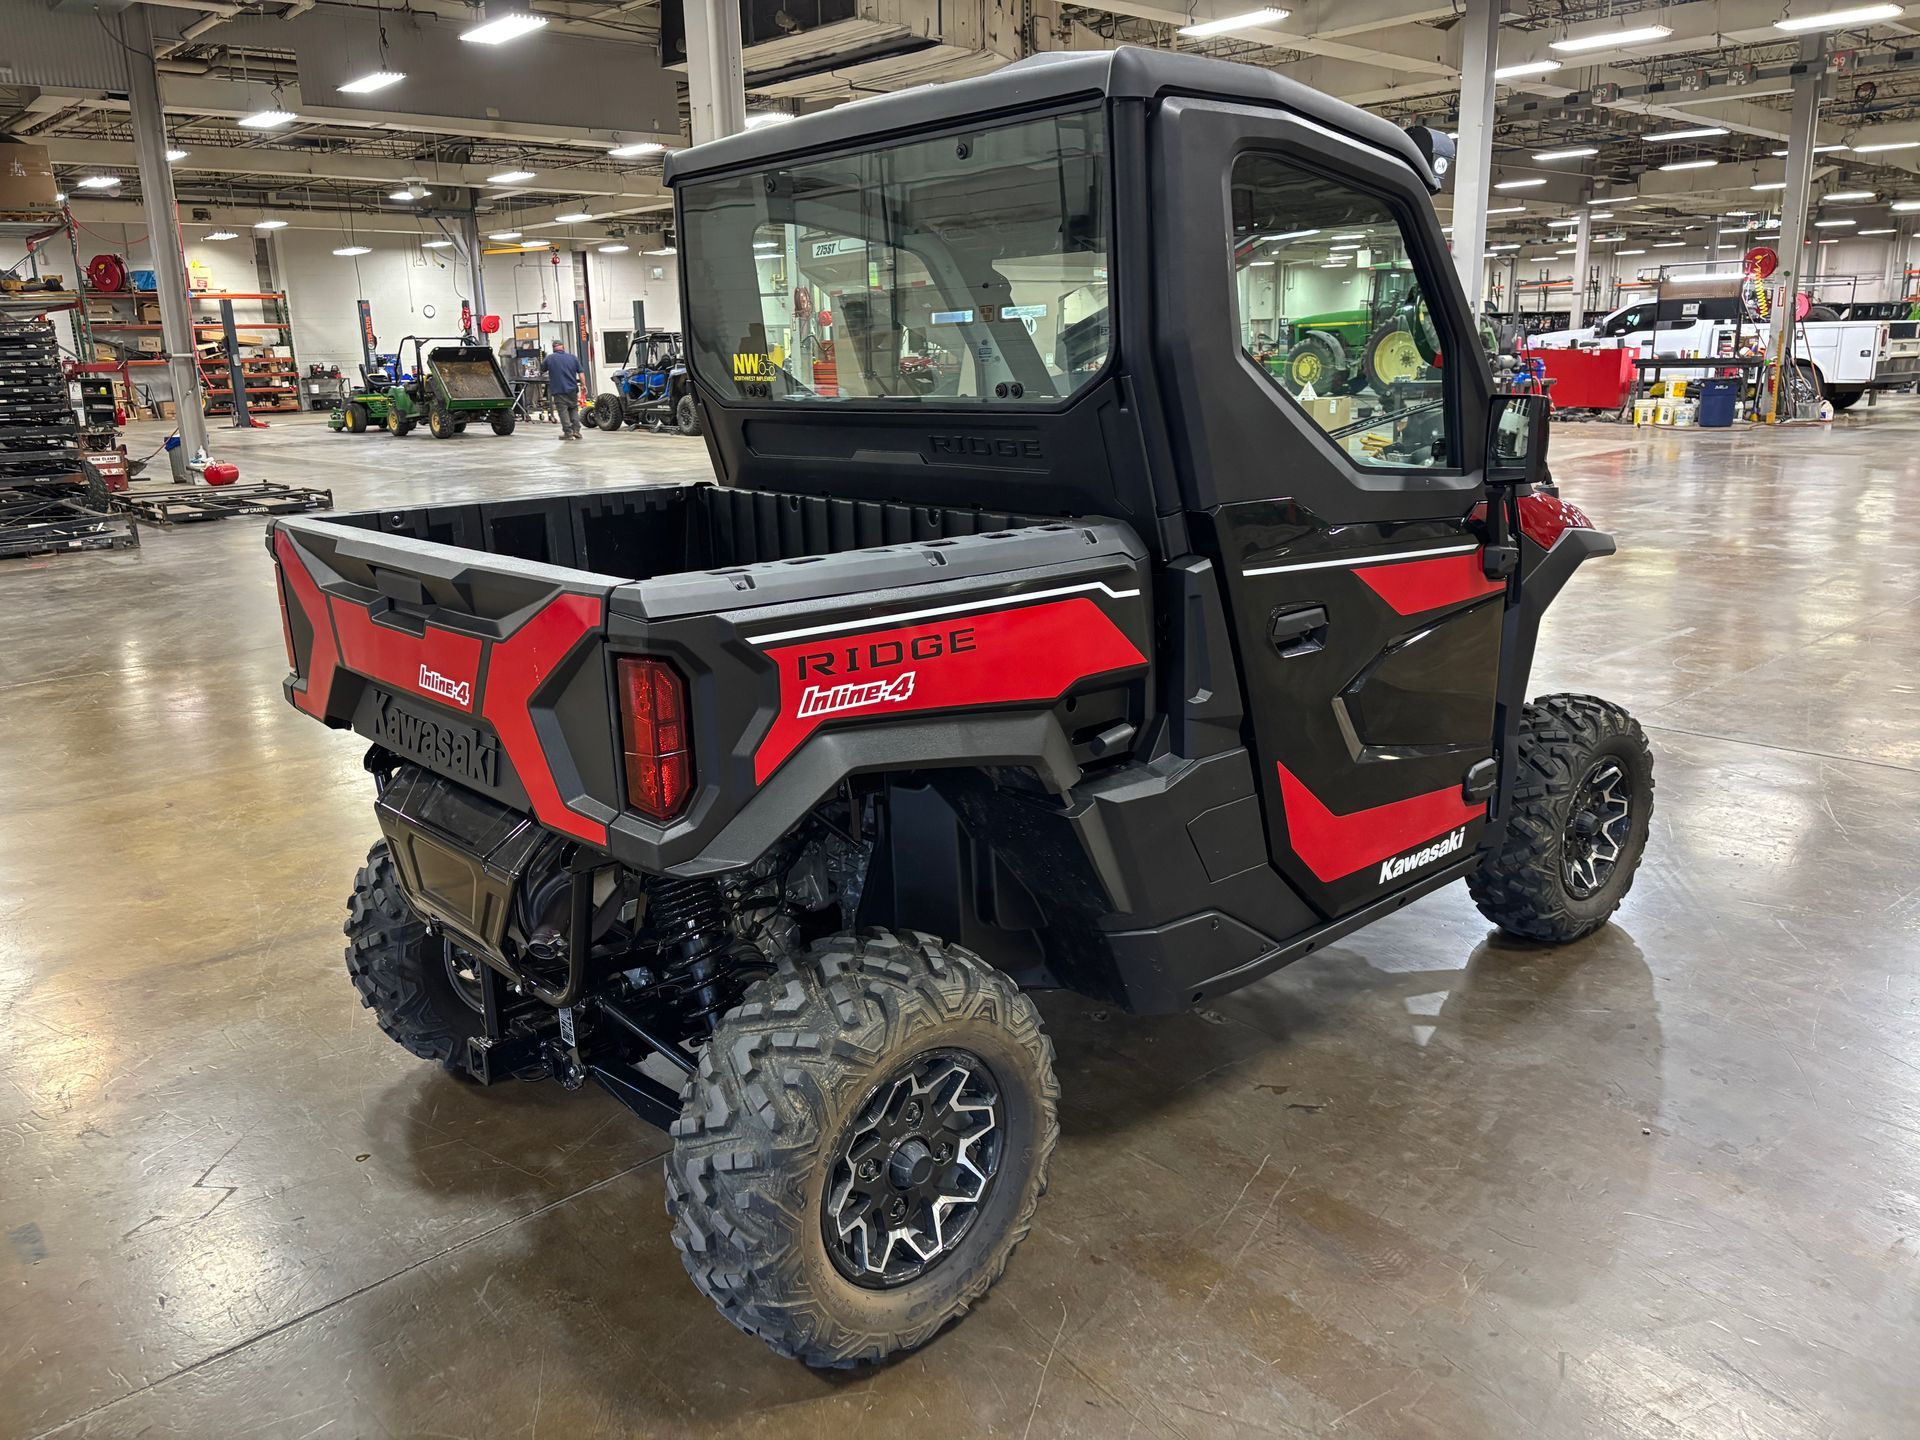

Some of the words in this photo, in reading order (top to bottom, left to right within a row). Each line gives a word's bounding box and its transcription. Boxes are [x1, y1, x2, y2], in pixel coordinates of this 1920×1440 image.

[1832, 56, 1846, 67] 99
[1685, 76, 1697, 85] 93
[1732, 70, 1745, 81] 95
[815, 243, 836, 256] 275ST
[733, 353, 759, 374] NW
[928, 434, 1042, 459] RIDGE
[798, 628, 976, 681] RIDGE
[418, 663, 470, 706] Inline-4
[797, 671, 916, 719] Inline-4
[372, 688, 499, 788] Kawasaki
[1378, 826, 1466, 885] Kawasaki
